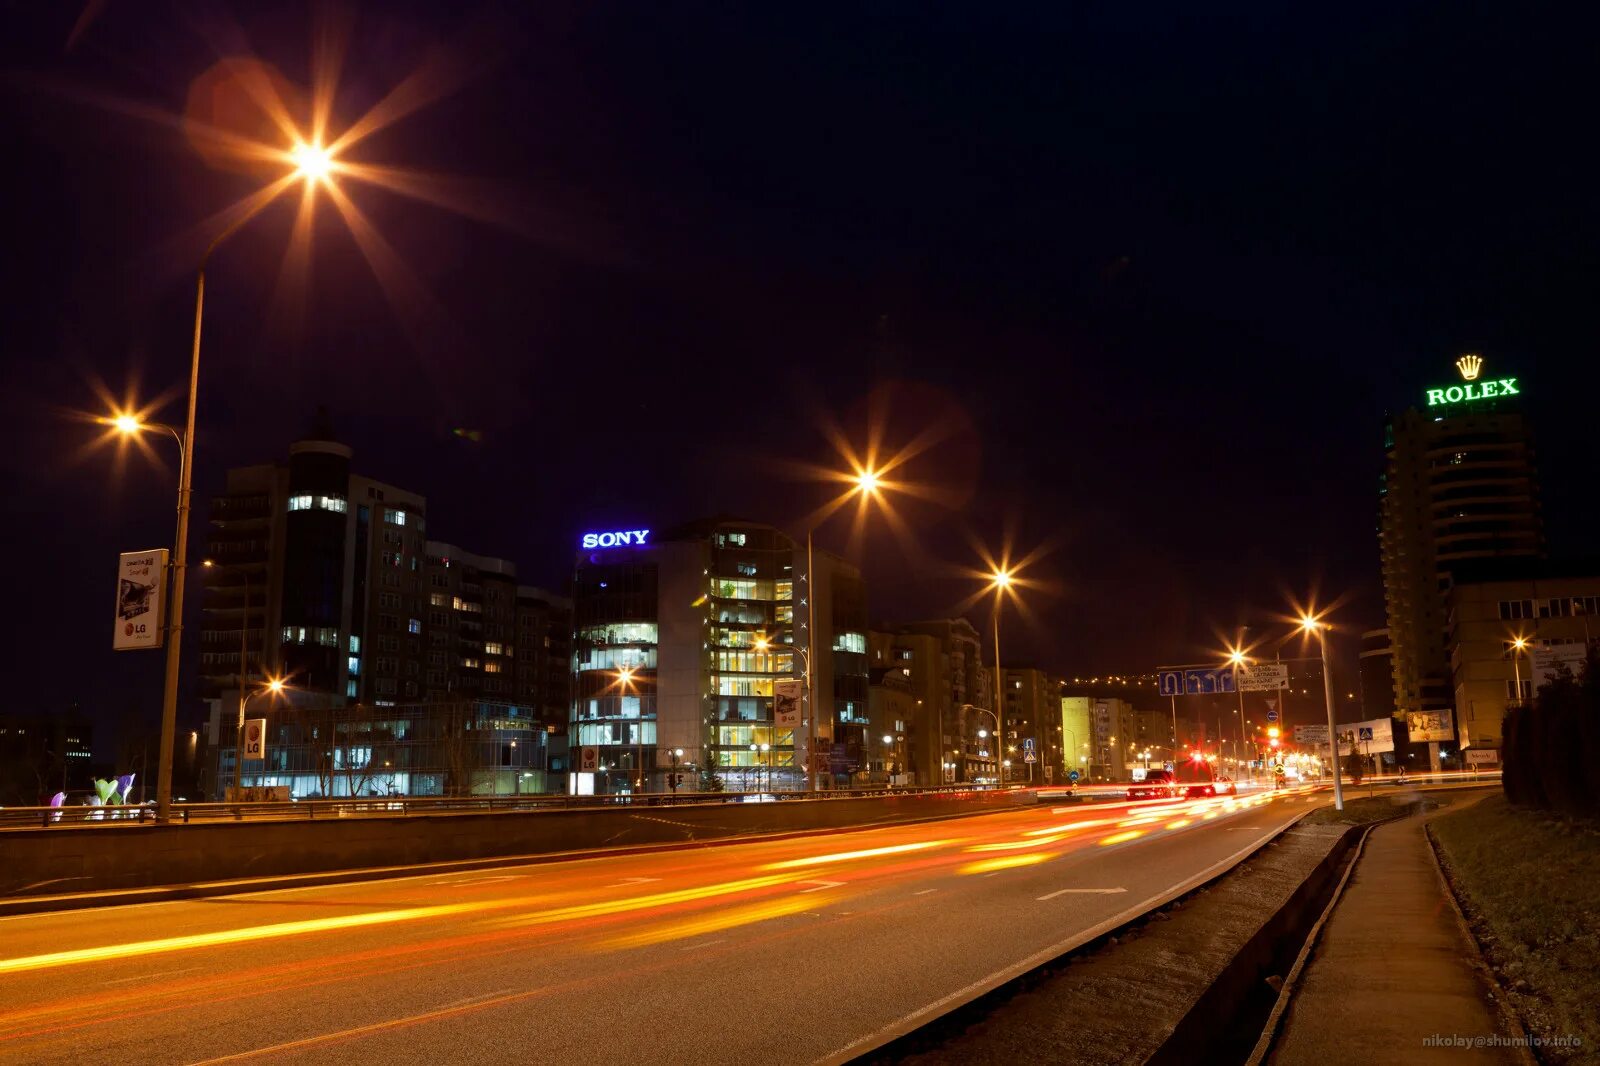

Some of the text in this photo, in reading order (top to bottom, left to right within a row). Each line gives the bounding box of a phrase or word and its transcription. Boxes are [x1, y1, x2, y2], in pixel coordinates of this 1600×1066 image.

[1426, 378, 1520, 406] ROLEX
[582, 529, 650, 549] SONY
[135, 624, 146, 633] LG
[247, 743, 259, 753] LG
[584, 761, 595, 769] LG
